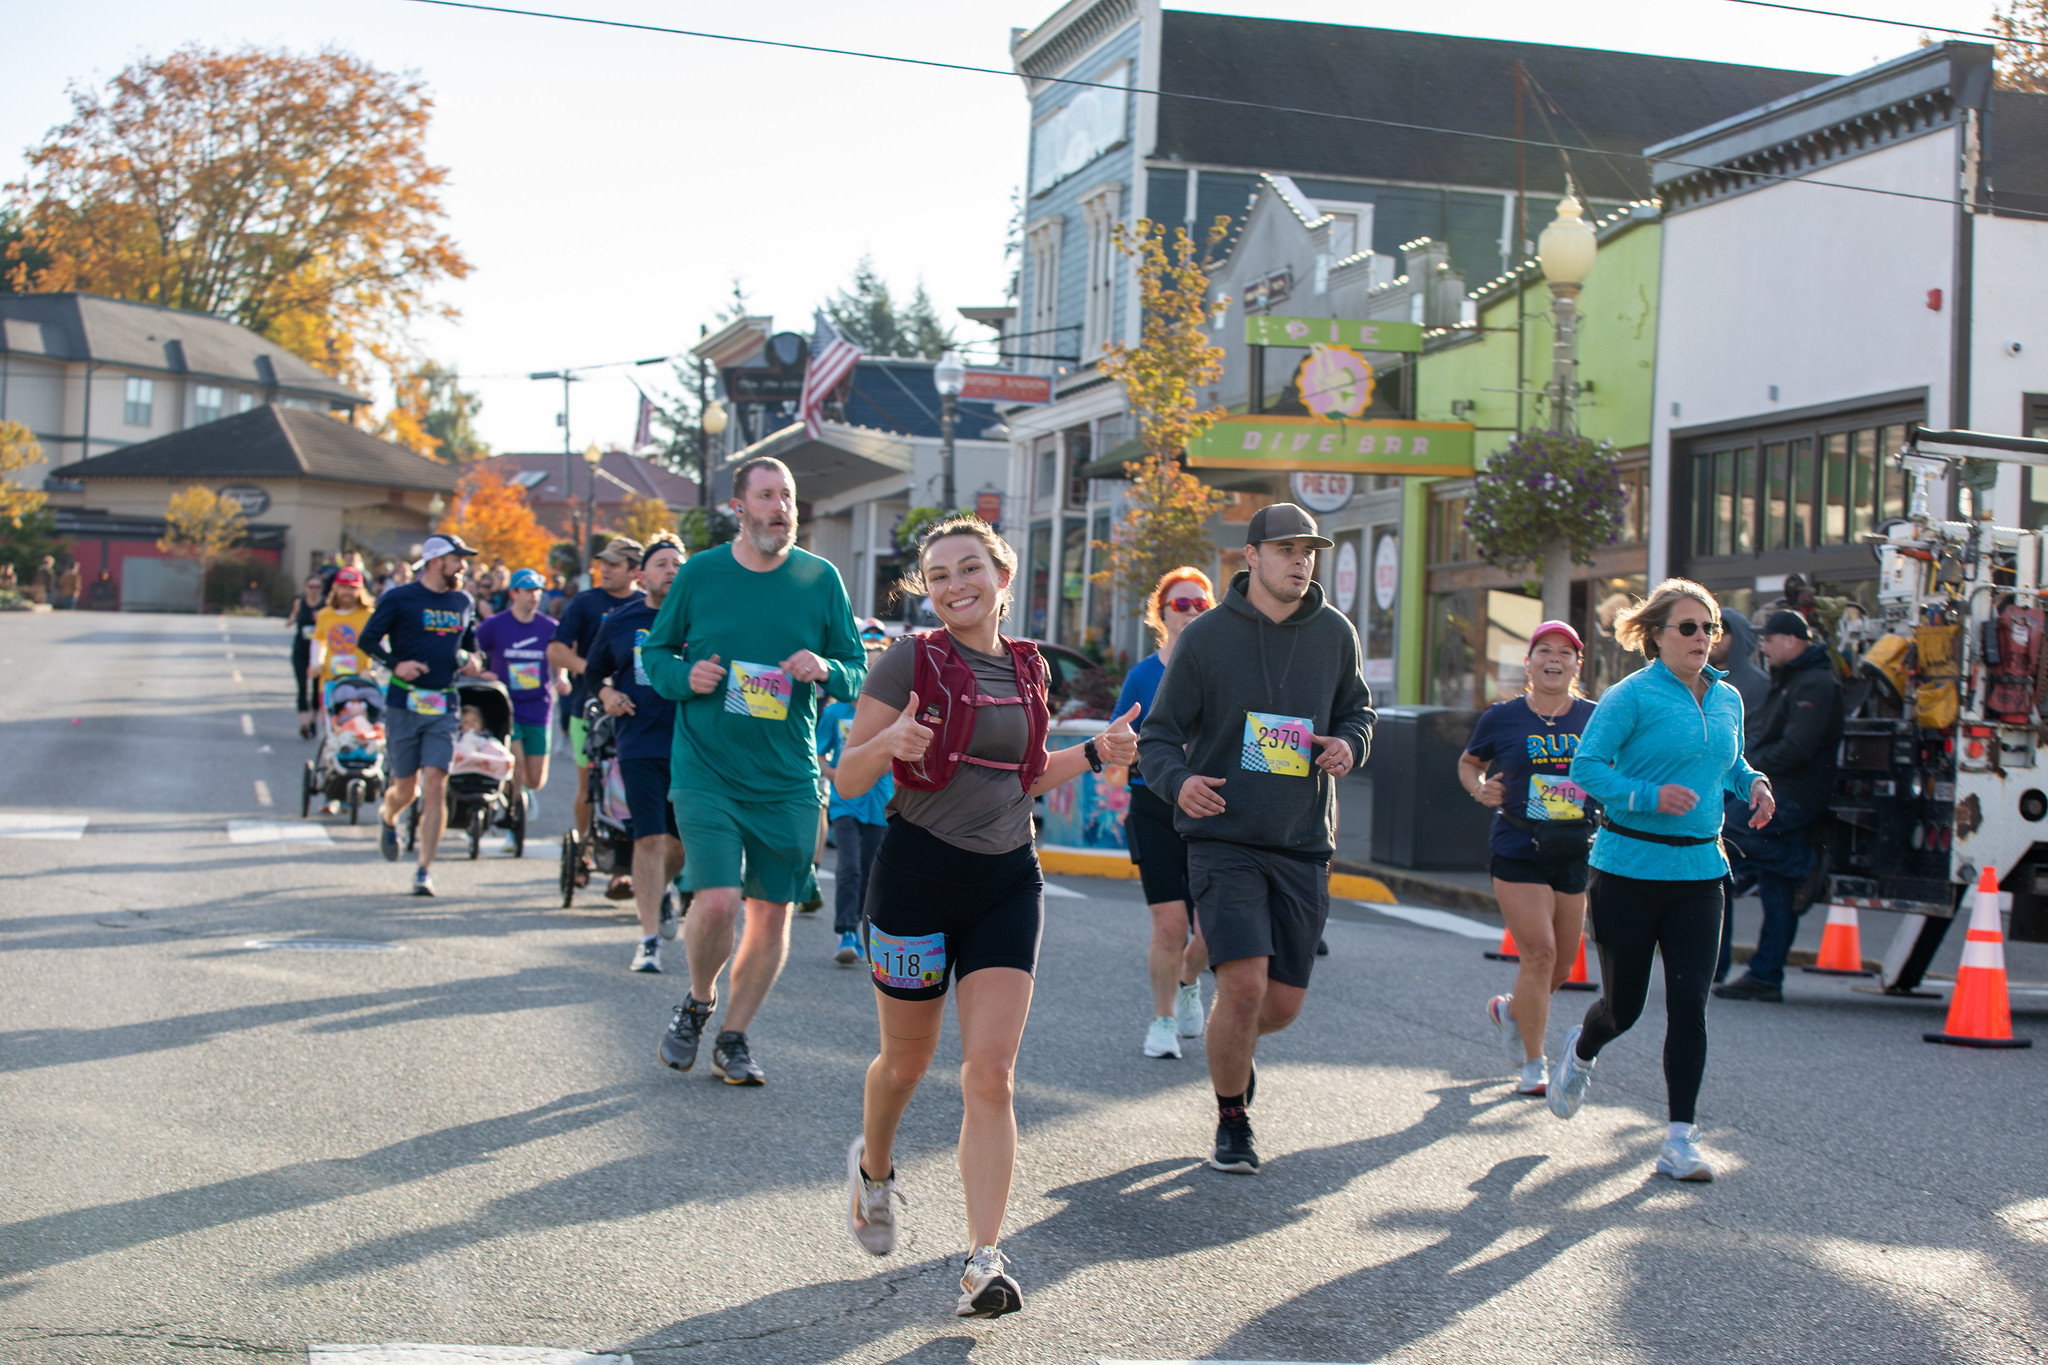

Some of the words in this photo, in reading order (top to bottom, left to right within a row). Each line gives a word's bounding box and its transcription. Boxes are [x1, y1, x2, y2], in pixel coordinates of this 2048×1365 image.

[1289, 321, 1379, 344] PIE
[1242, 431, 1337, 452] DIVE
[1357, 435, 1430, 456] BAR
[1302, 473, 1325, 494] PIE
[423, 608, 461, 628] RUN
[1258, 726, 1300, 751] 2379
[1541, 784, 1577, 804] 2219
[883, 951, 921, 978] 118
